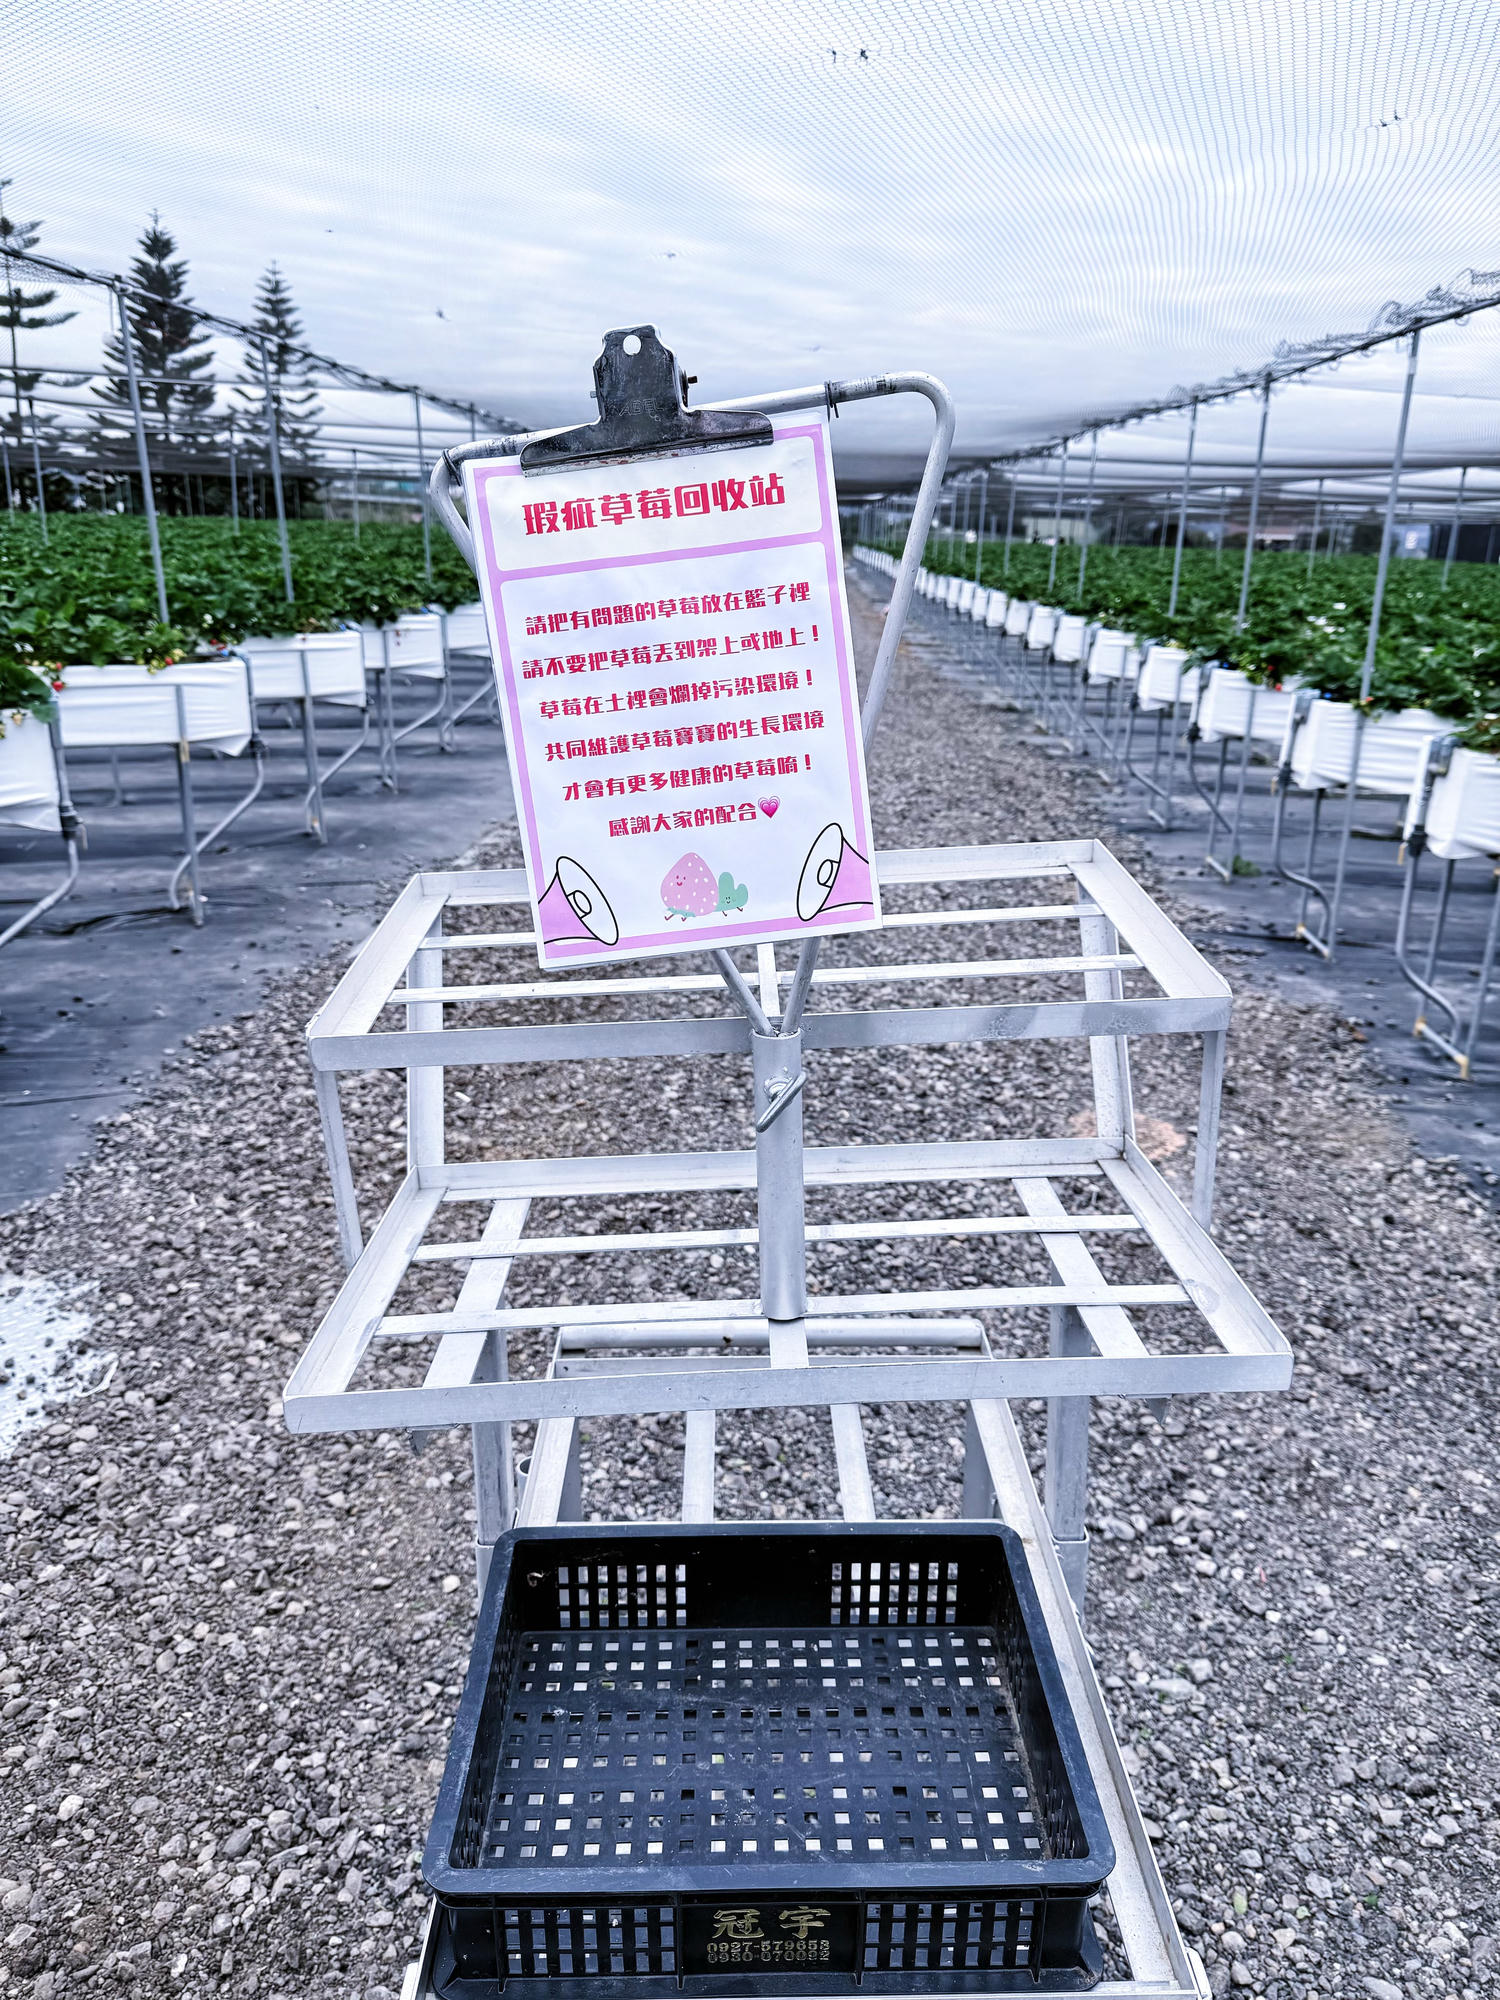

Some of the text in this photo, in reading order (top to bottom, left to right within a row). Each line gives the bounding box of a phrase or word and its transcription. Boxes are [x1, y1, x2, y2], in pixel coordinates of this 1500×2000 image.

[522, 472, 786, 536] 瑕疵草莓回收站
[524, 581, 811, 636] 請把有問題的草莓放在籃子裡
[544, 709, 825, 762] 共同維護草莓寶寶的生長環境
[608, 802, 758, 837] 感謝大家的配合
